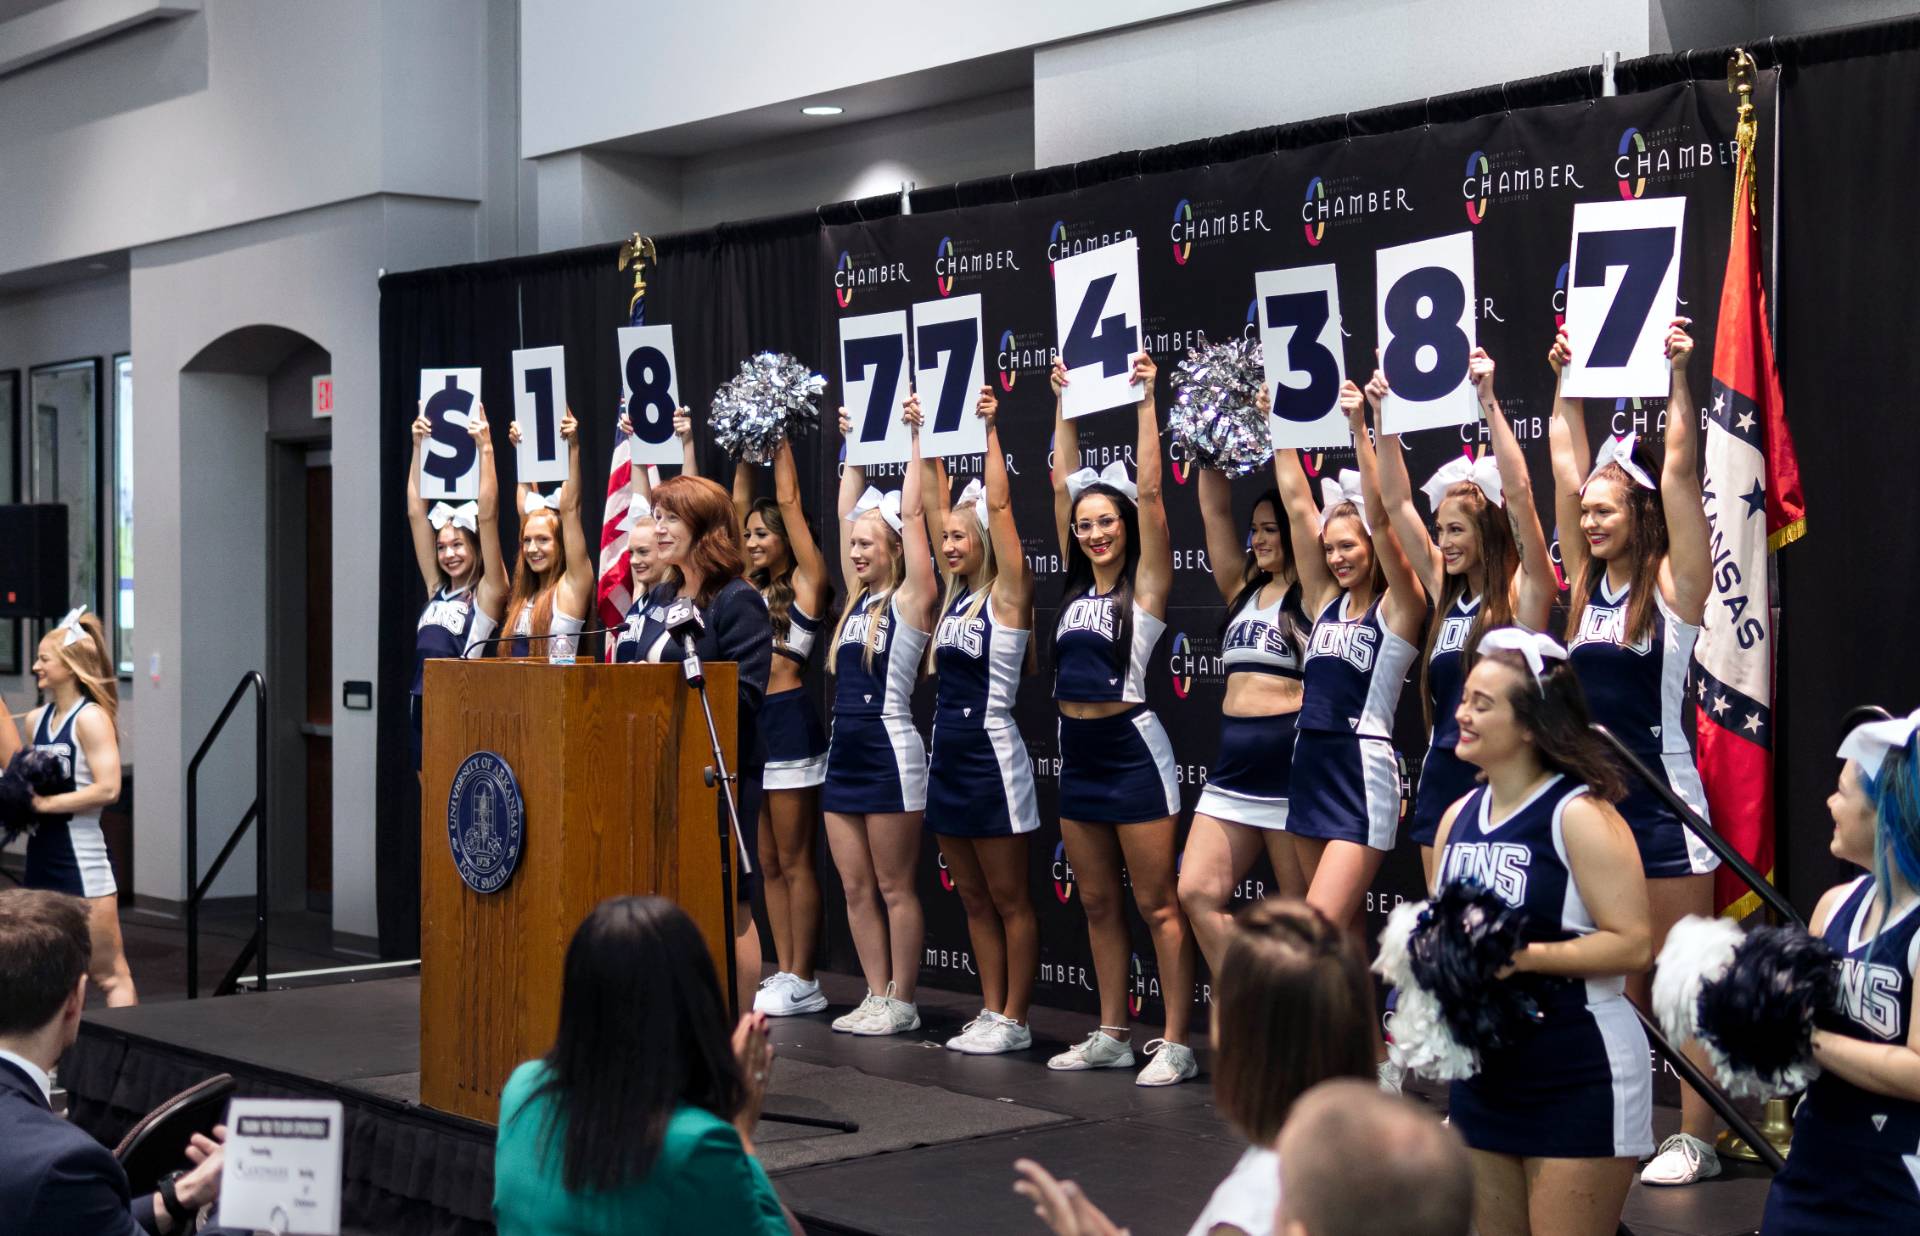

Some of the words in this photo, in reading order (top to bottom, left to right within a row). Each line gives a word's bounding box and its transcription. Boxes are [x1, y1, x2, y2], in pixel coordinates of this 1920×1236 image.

[1302, 188, 1414, 222] CHAMBER
[1462, 164, 1585, 199] CHAMBER
[935, 250, 1020, 276] CHAMBER
[1170, 209, 1271, 243] CHAMBER
[834, 262, 911, 288] CHAMBER
[1574, 226, 1677, 369] 7
[998, 347, 1057, 369] CHAMB
[1062, 273, 1138, 379] 4
[1144, 329, 1205, 353] AMBER
[1265, 290, 1340, 422] 3
[1383, 266, 1471, 402] 8
[525, 367, 556, 462] 1
[626, 346, 675, 444] 8
[844, 333, 904, 443] 7
[917, 317, 978, 434] 7
[423, 375, 477, 492] $
[1170, 655, 1225, 675] CHAM
[450, 757, 480, 830] UNIVERSITY
[481, 757, 493, 770] OF
[493, 765, 518, 838] ARKANSAS
[460, 857, 479, 887] FORT
[480, 864, 508, 889] SMITH
